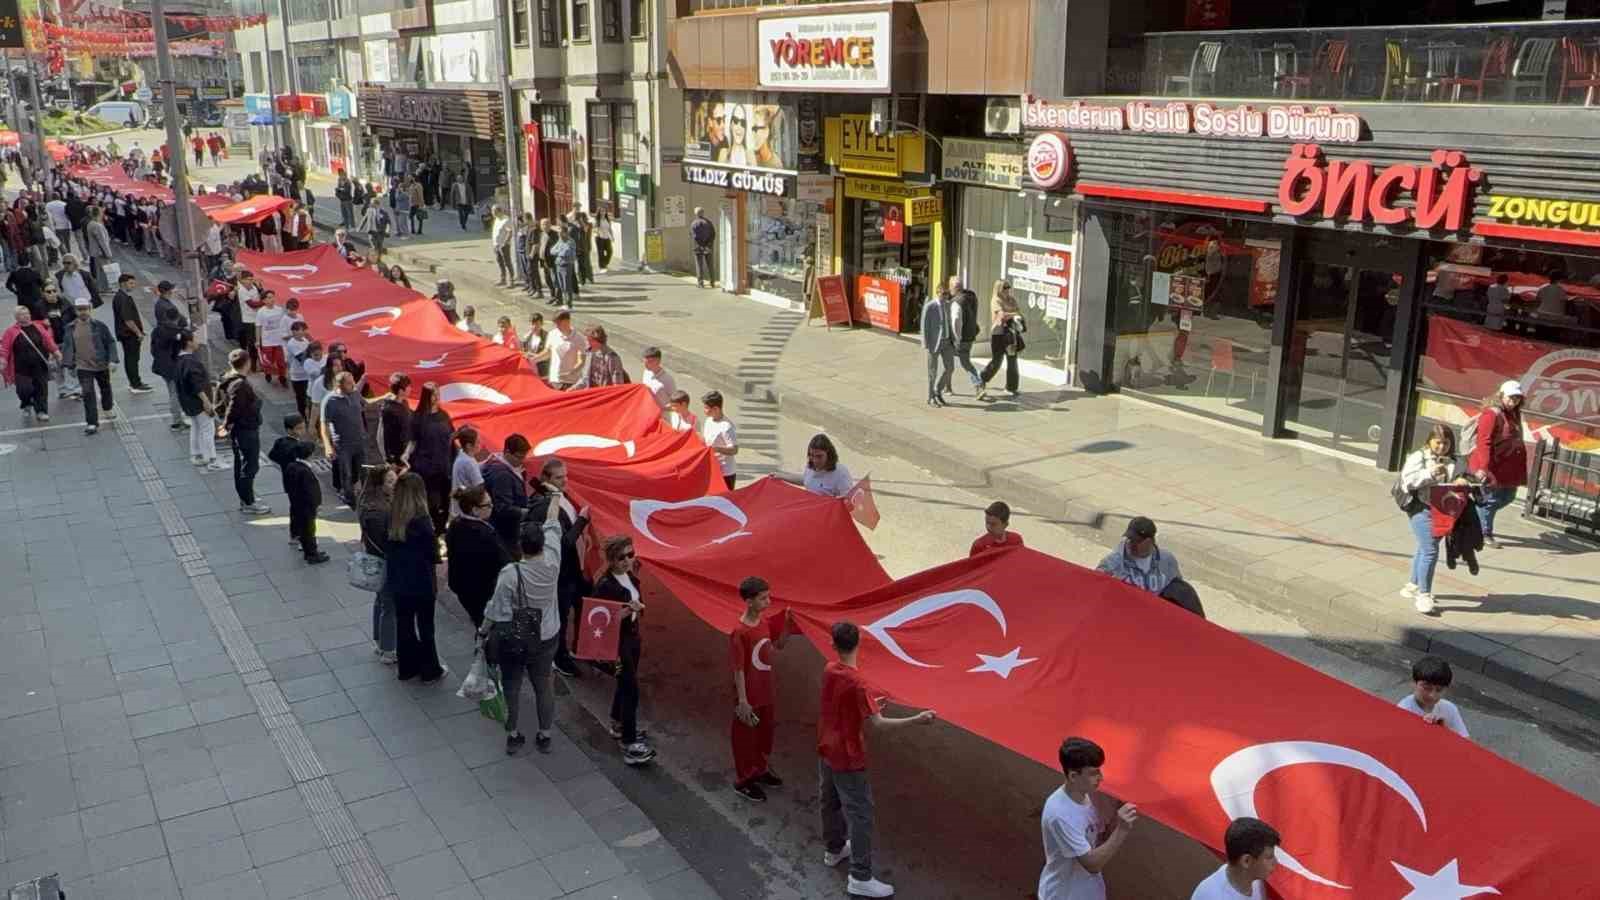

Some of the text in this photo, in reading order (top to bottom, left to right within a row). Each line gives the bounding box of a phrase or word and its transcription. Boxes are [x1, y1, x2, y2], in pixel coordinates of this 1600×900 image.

[1128, 103, 1188, 132] Usulü
[1194, 104, 1262, 136] Soslu
[1268, 105, 1358, 141] Dürüm
[962, 160, 995, 171] ALTIN
[685, 166, 785, 196] YILDIZ GÜMÜŞ
